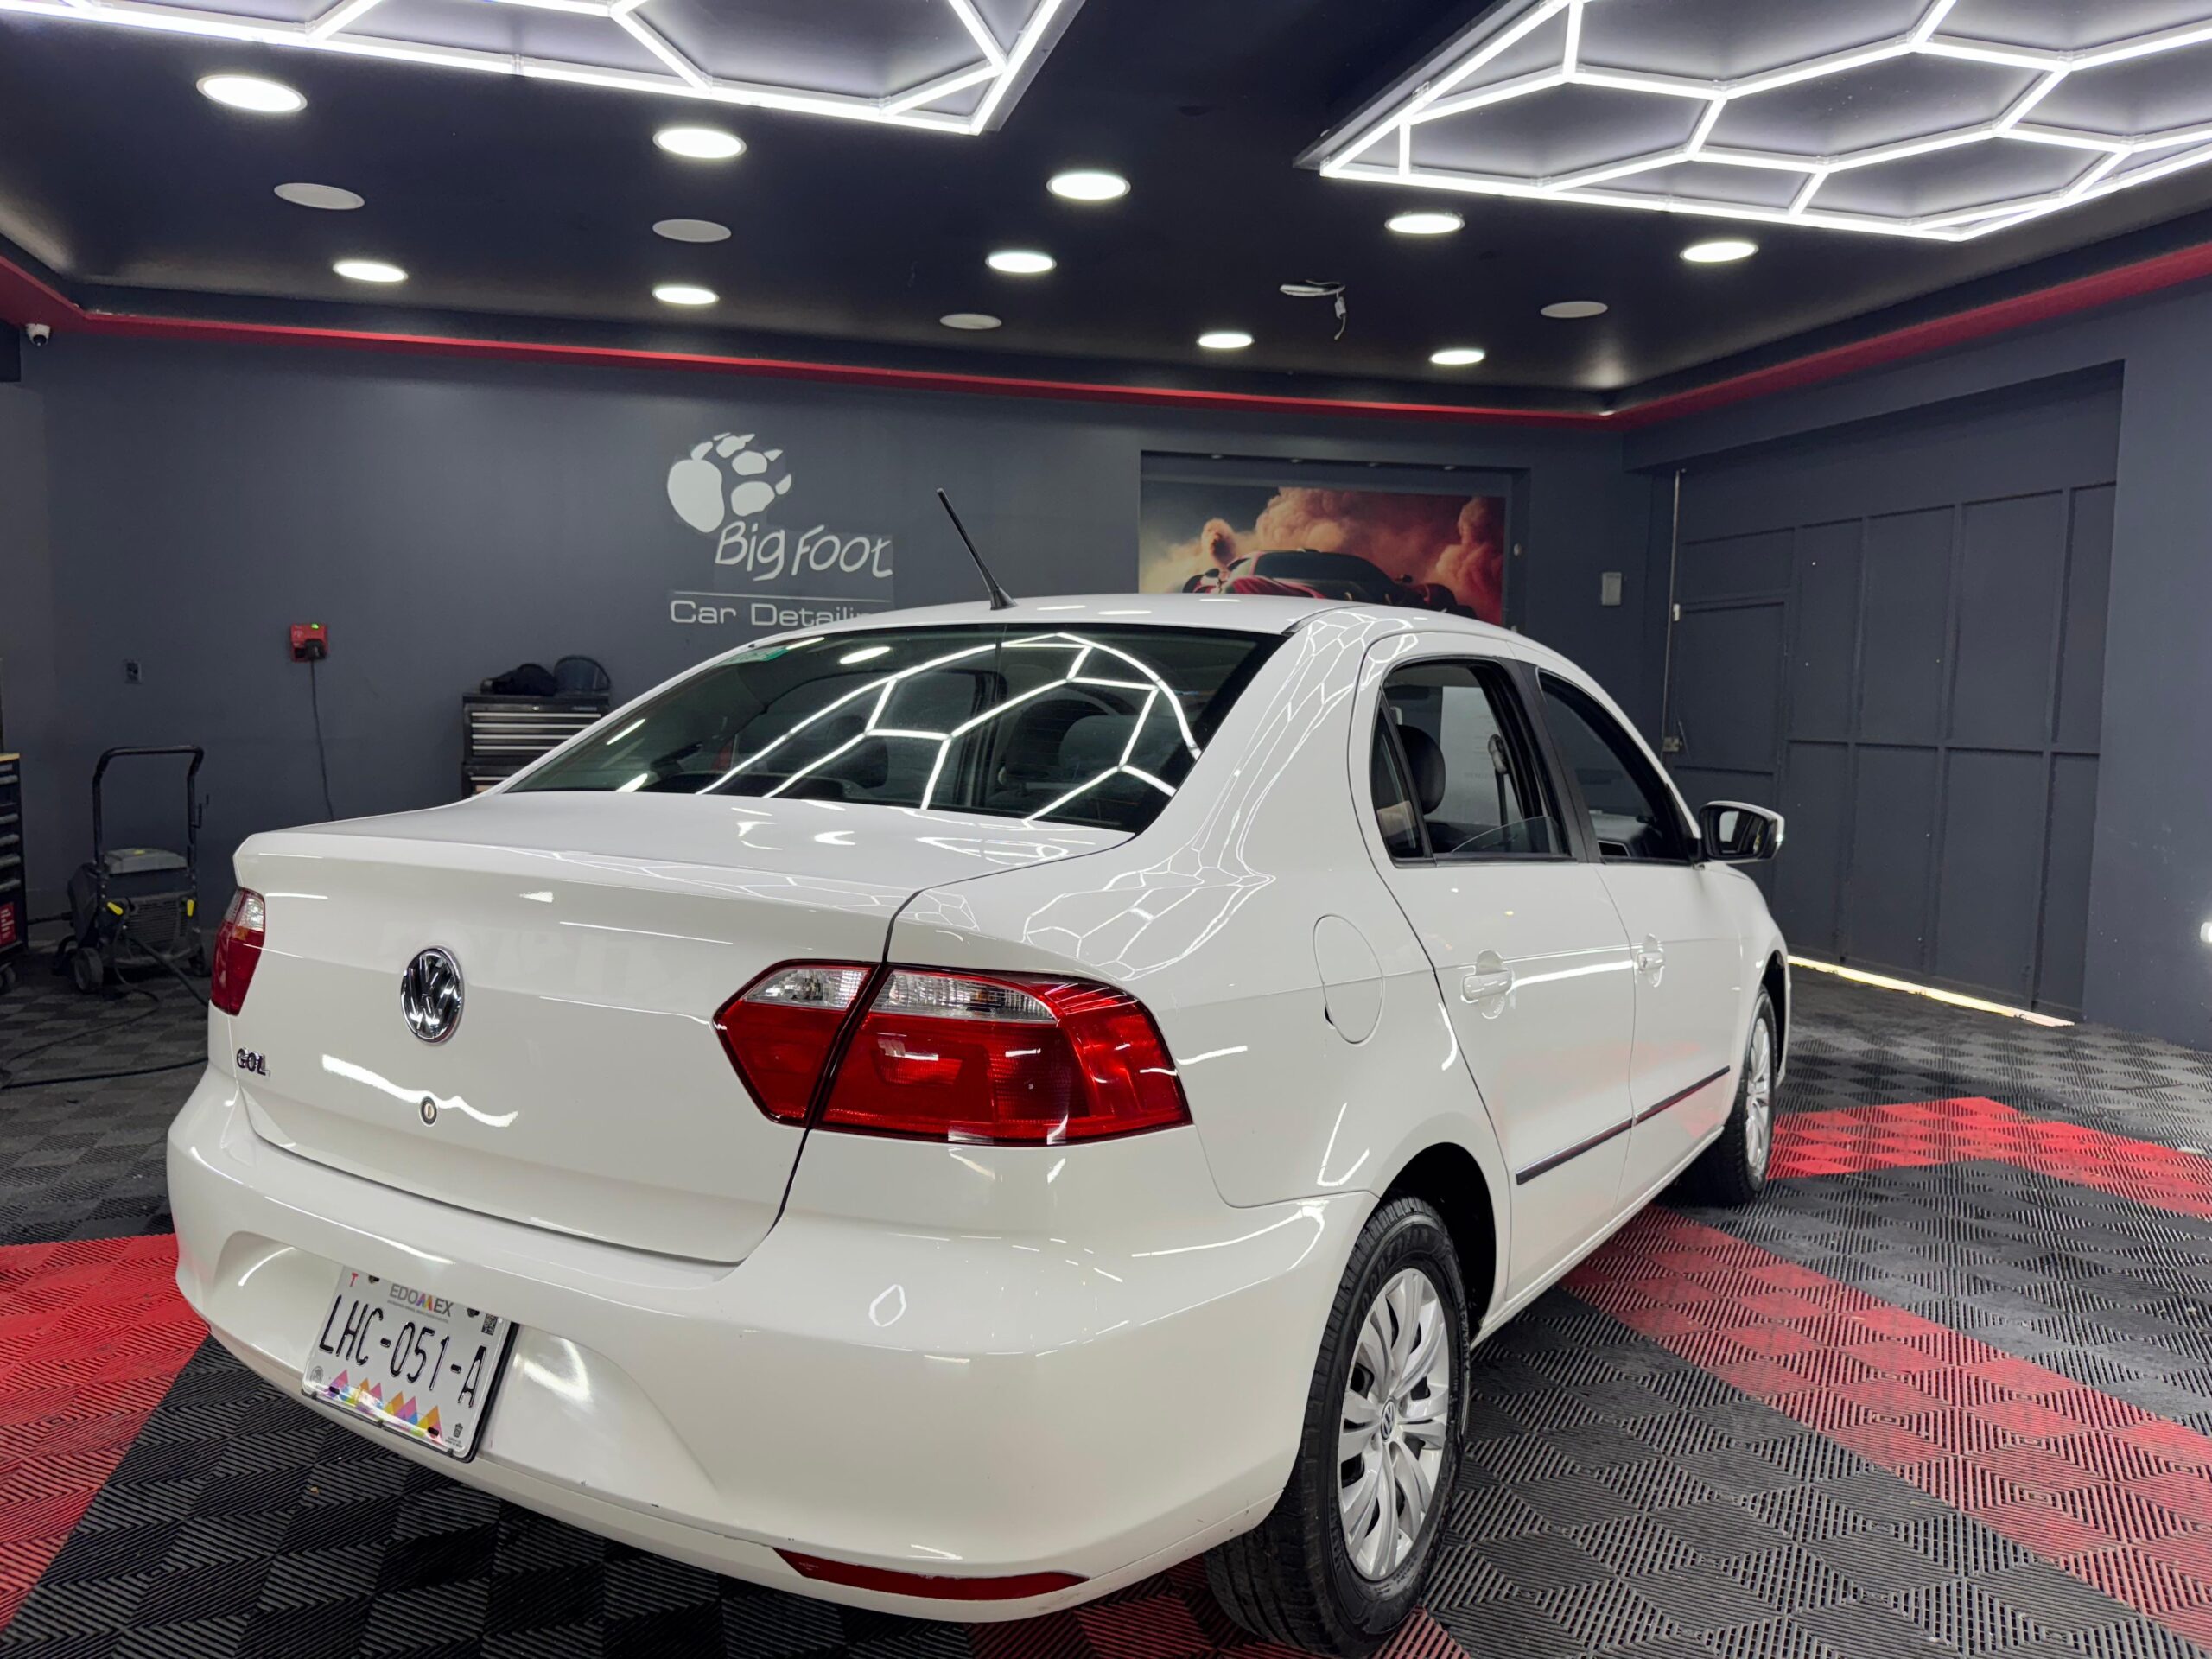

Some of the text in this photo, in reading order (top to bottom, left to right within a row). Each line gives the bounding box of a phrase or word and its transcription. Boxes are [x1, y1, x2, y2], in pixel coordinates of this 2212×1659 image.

[671, 600, 737, 624] Car
[236, 1047, 268, 1077] GOL
[318, 1294, 487, 1408] LHC-051-A
